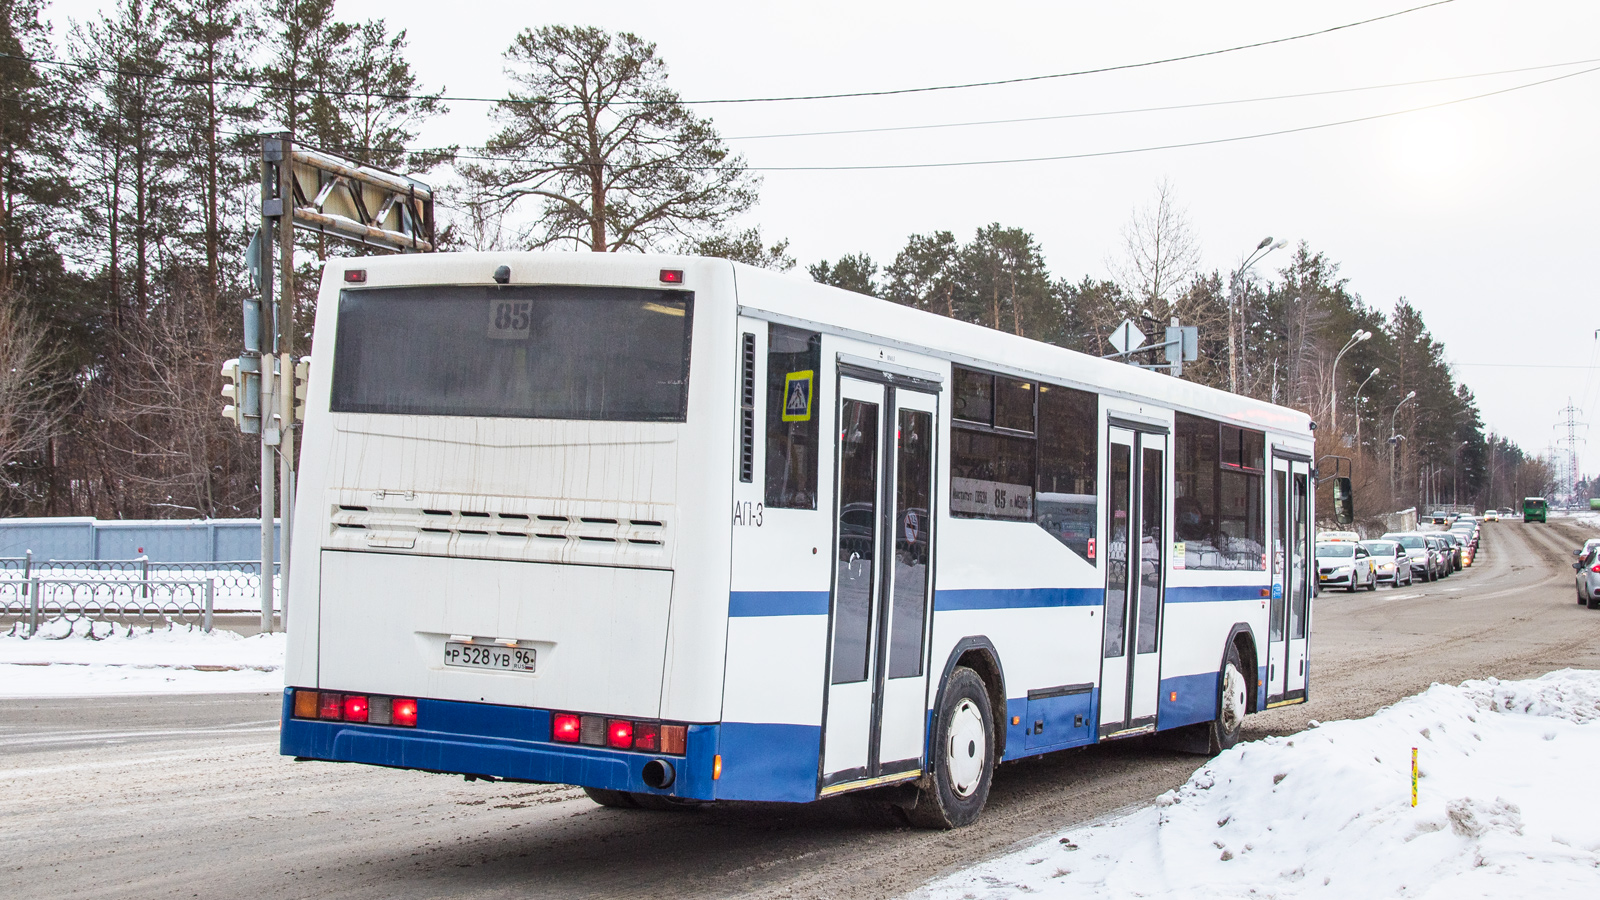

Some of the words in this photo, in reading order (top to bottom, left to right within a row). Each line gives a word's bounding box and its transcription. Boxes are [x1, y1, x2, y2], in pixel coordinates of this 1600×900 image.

[495, 302, 529, 331] 85
[994, 488, 1007, 509] 85
[733, 500, 763, 527] АП-3
[515, 650, 530, 664] 96
